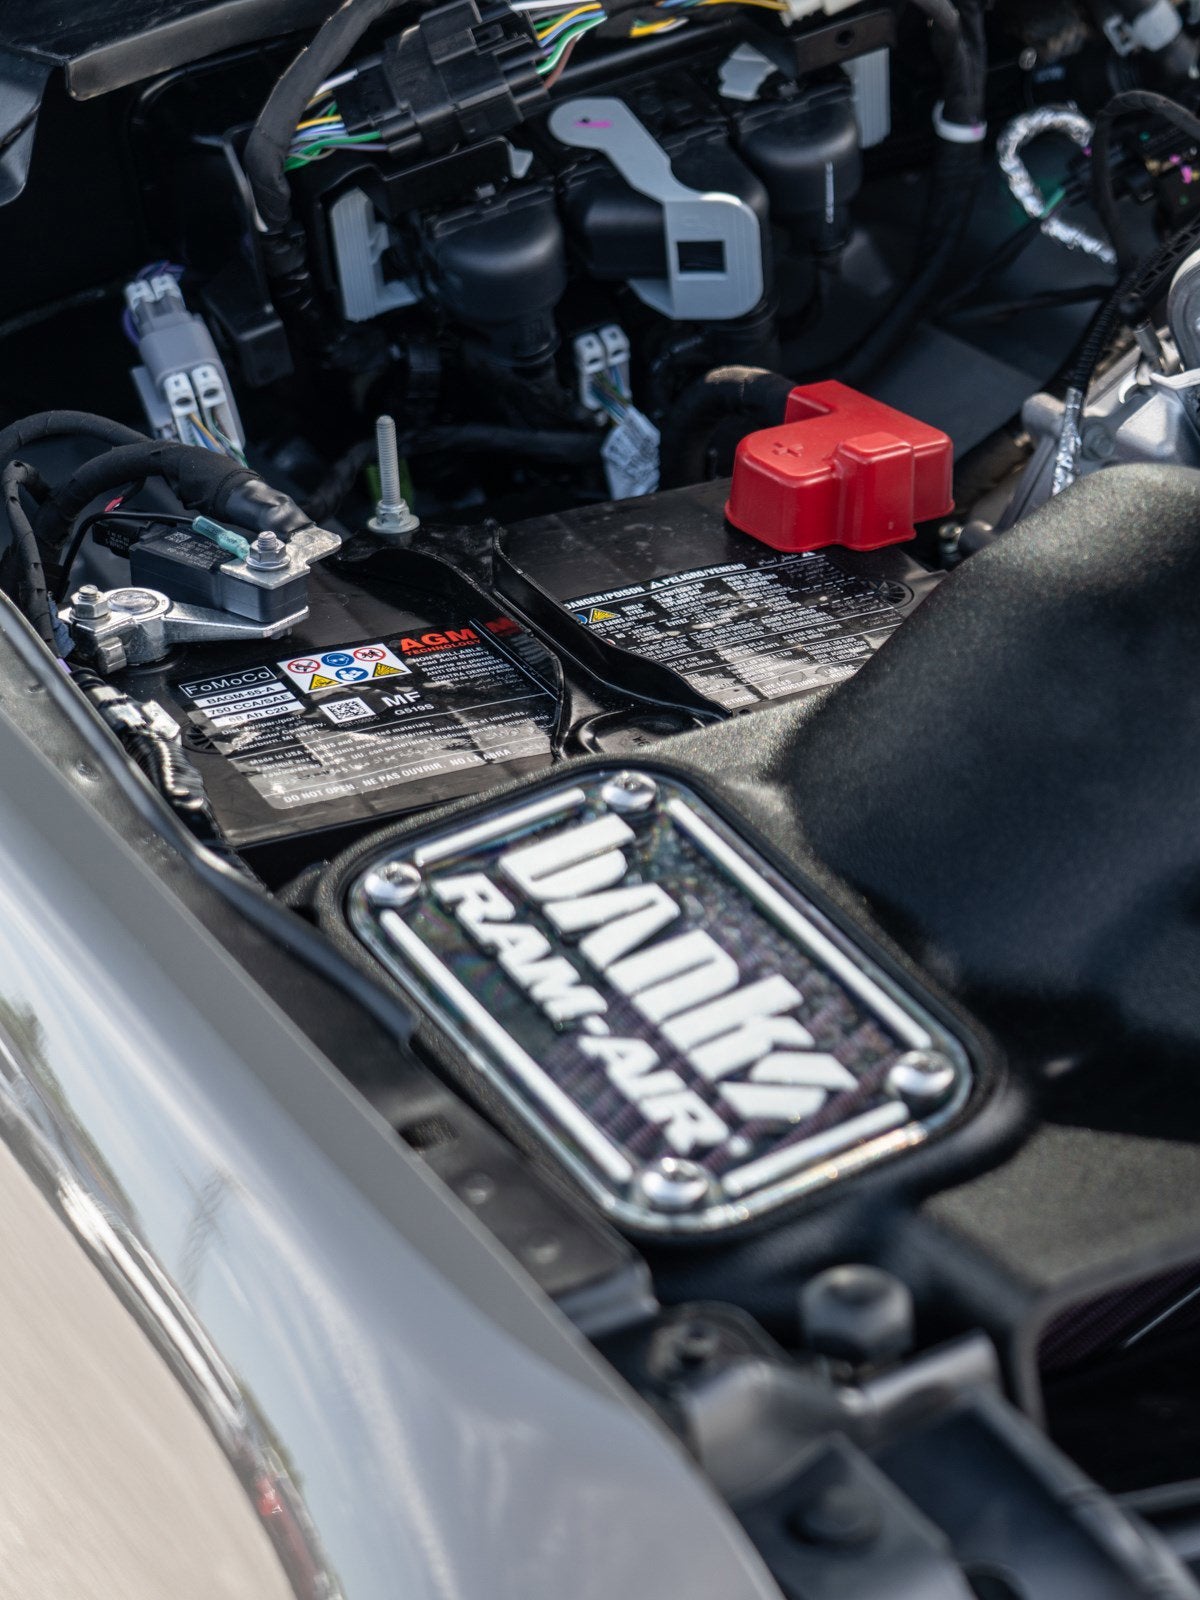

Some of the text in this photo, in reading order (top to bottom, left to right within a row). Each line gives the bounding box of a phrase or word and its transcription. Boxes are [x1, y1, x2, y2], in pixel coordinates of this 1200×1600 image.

[400, 628, 478, 652] AGM
[403, 639, 481, 656] TECHNOLOGY
[631, 643, 663, 653] ULFURIC
[186, 672, 270, 694] FoMoCo
[384, 691, 421, 707] MF
